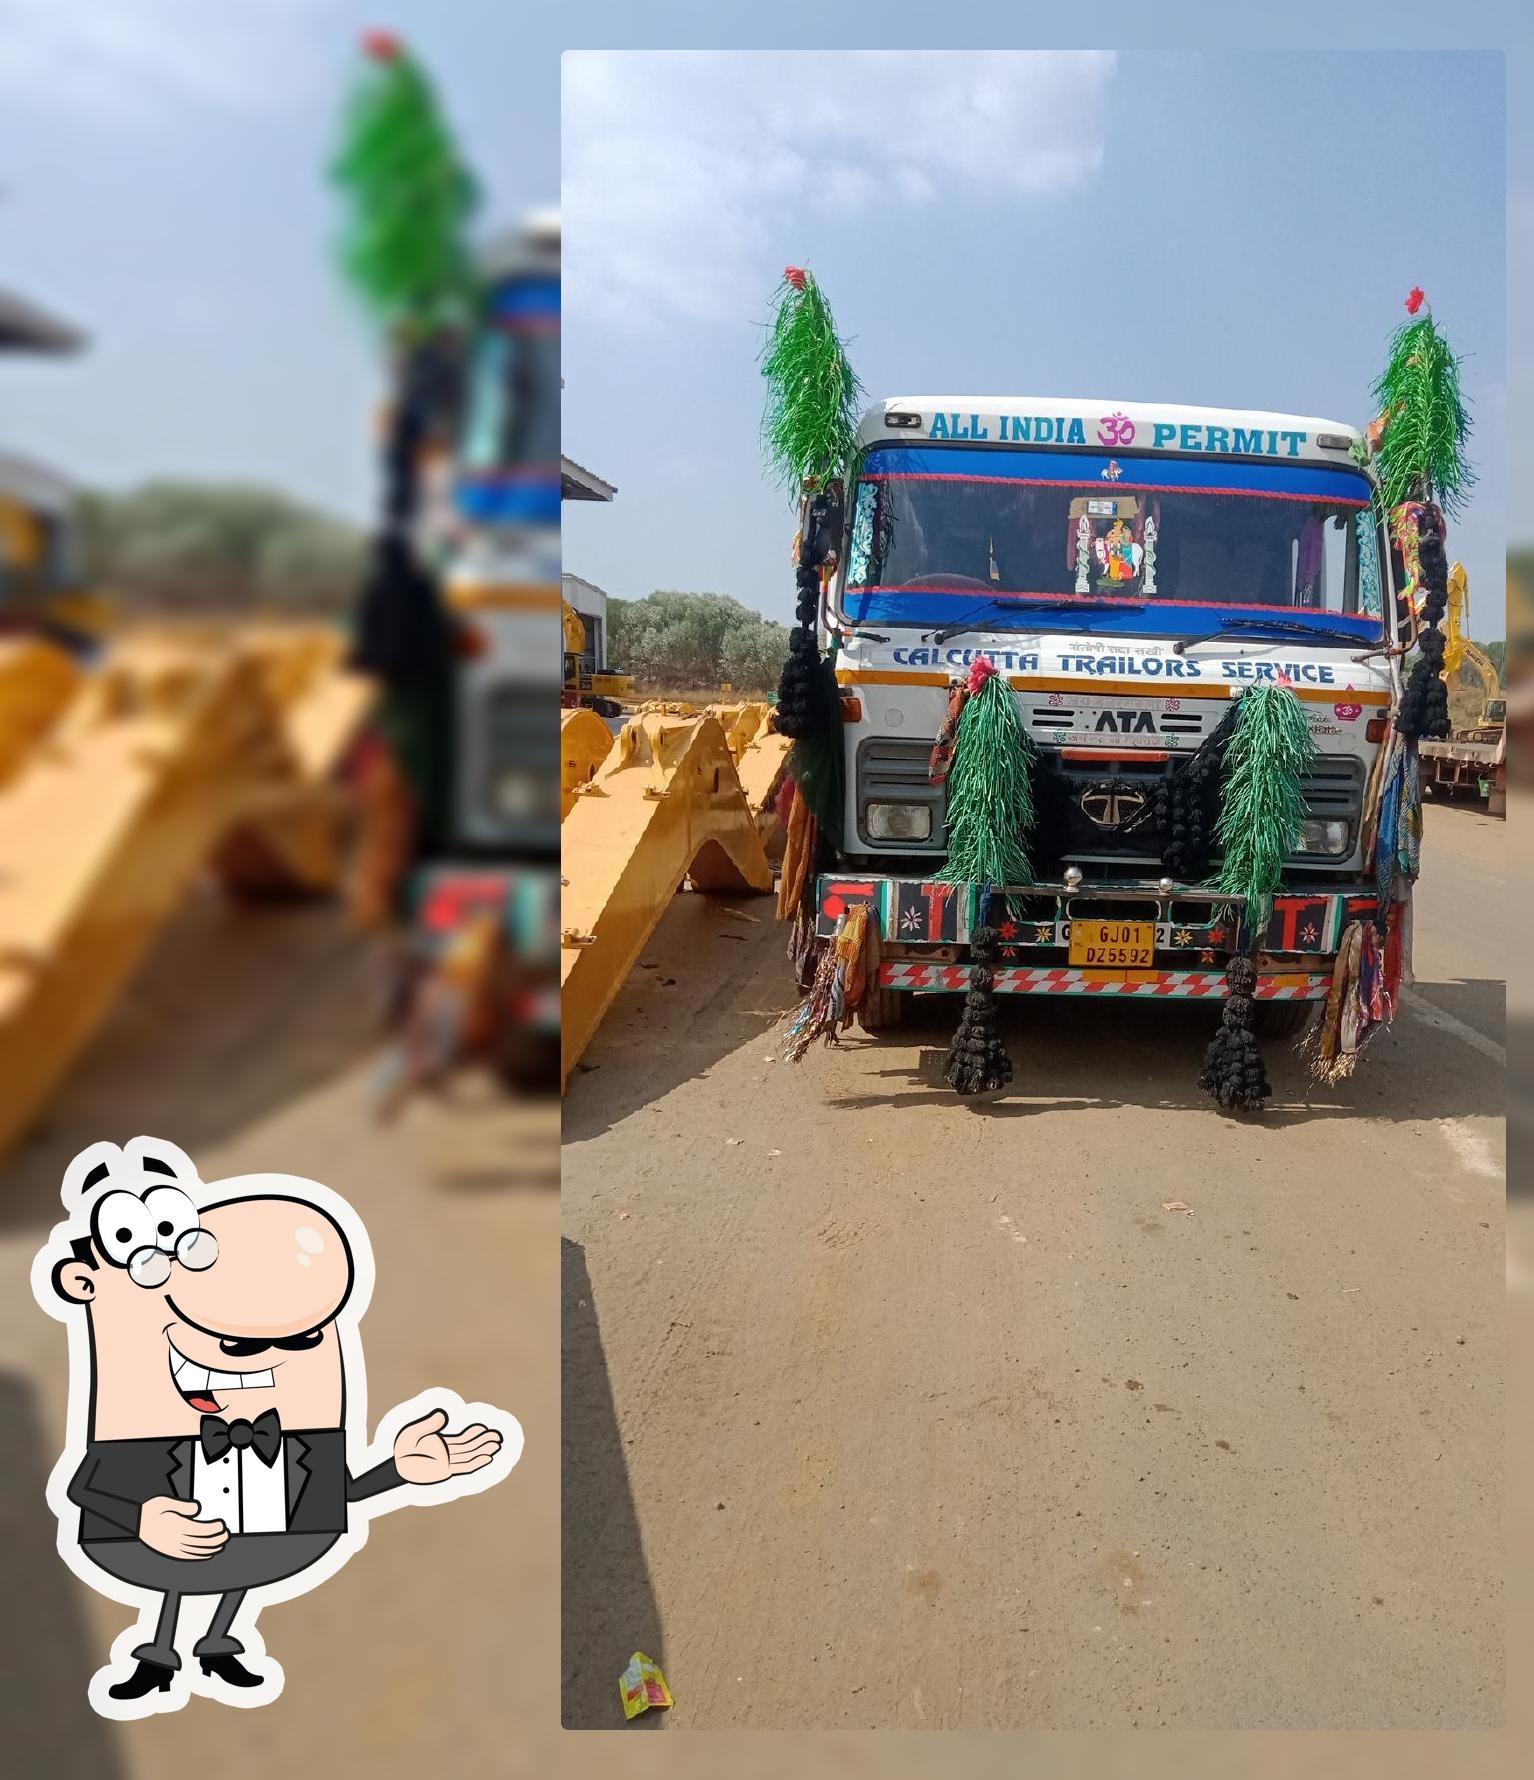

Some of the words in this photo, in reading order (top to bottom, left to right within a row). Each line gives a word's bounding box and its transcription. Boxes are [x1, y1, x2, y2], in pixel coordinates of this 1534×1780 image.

[929, 412, 988, 440] ALL
[999, 416, 1086, 444] INDIA
[1152, 423, 1307, 456] PERMIT
[893, 648, 1039, 671] CALCUTTA
[1057, 654, 1201, 677] TRAILORS
[1221, 661, 1335, 684] SERVICE
[1100, 925, 1140, 943] GJ01
[1086, 947, 1149, 963] DZ5592
